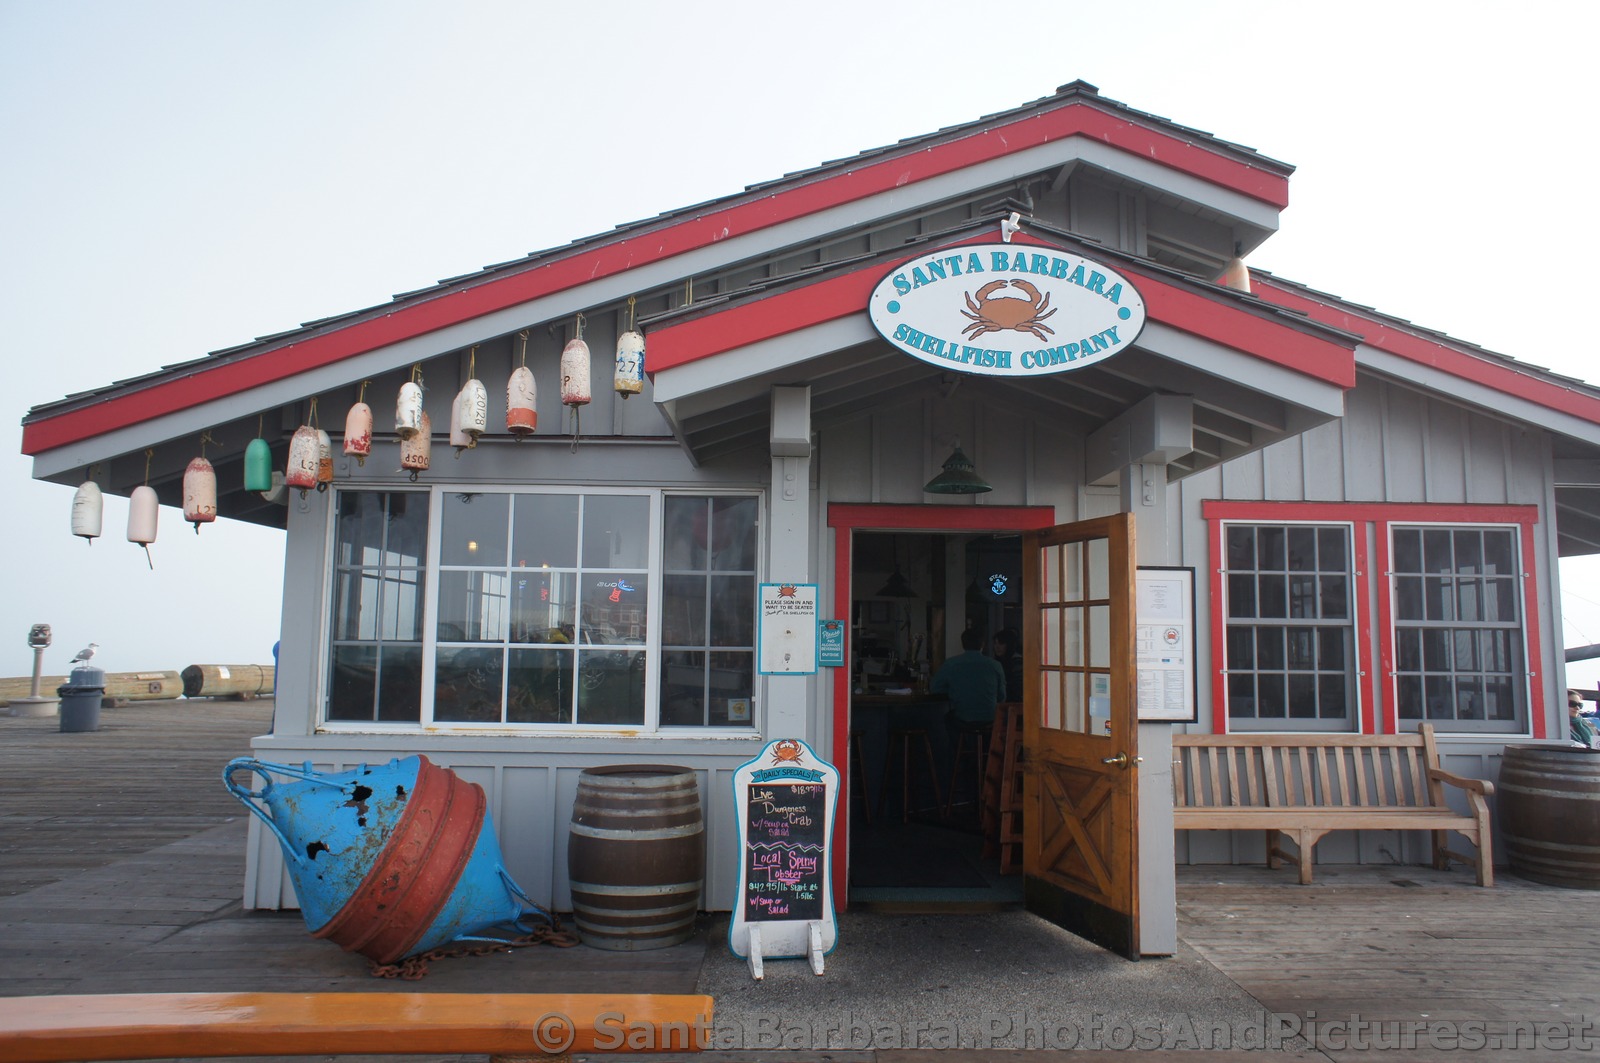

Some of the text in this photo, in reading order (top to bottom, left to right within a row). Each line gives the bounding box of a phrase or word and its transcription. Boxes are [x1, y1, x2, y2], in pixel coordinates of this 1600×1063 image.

[892, 251, 1123, 305] SANTA BARBARA
[892, 323, 1122, 369] SHELLFISH COMPANY
[763, 768, 811, 779] DAILY SPECIALS
[762, 801, 807, 820] Dungeness
[789, 812, 812, 826] Crab
[753, 850, 817, 875] Local Spiny
[768, 865, 803, 882] Lobster
